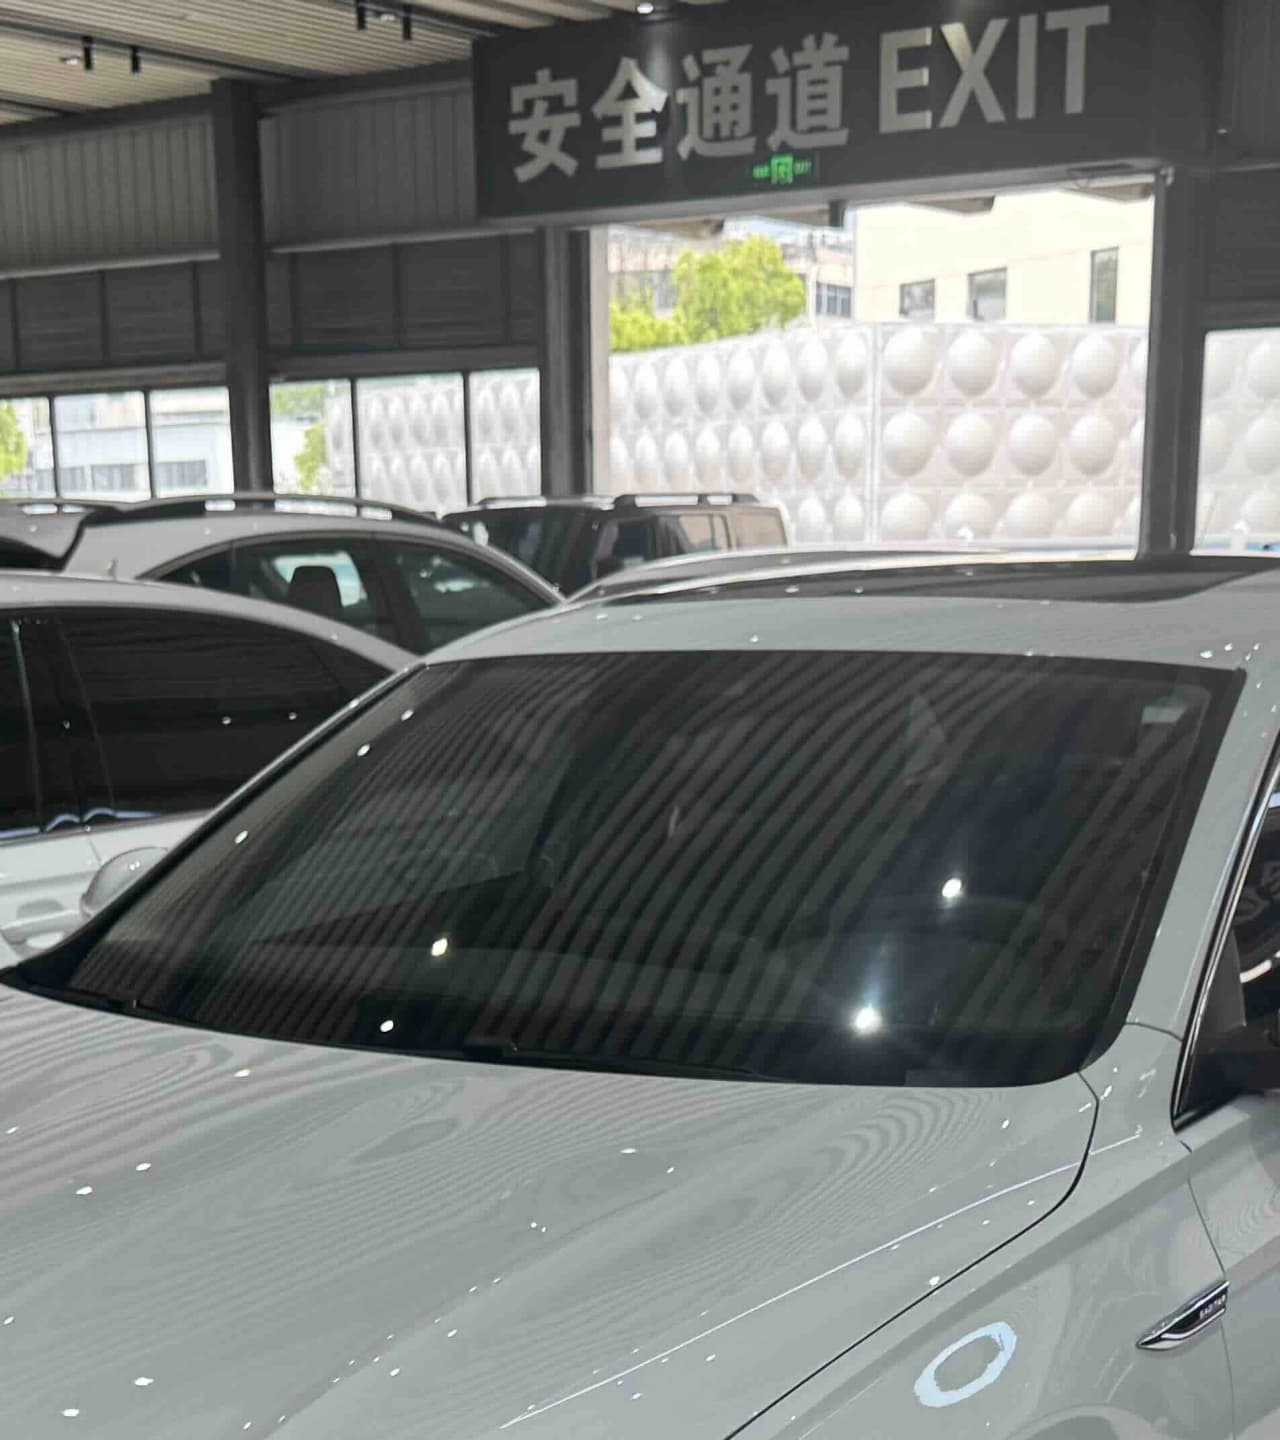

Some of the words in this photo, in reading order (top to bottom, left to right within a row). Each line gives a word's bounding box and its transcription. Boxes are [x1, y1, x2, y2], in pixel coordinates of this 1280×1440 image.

[506, 30, 851, 185] 安全通道
[878, 3, 1112, 135] EXIT
